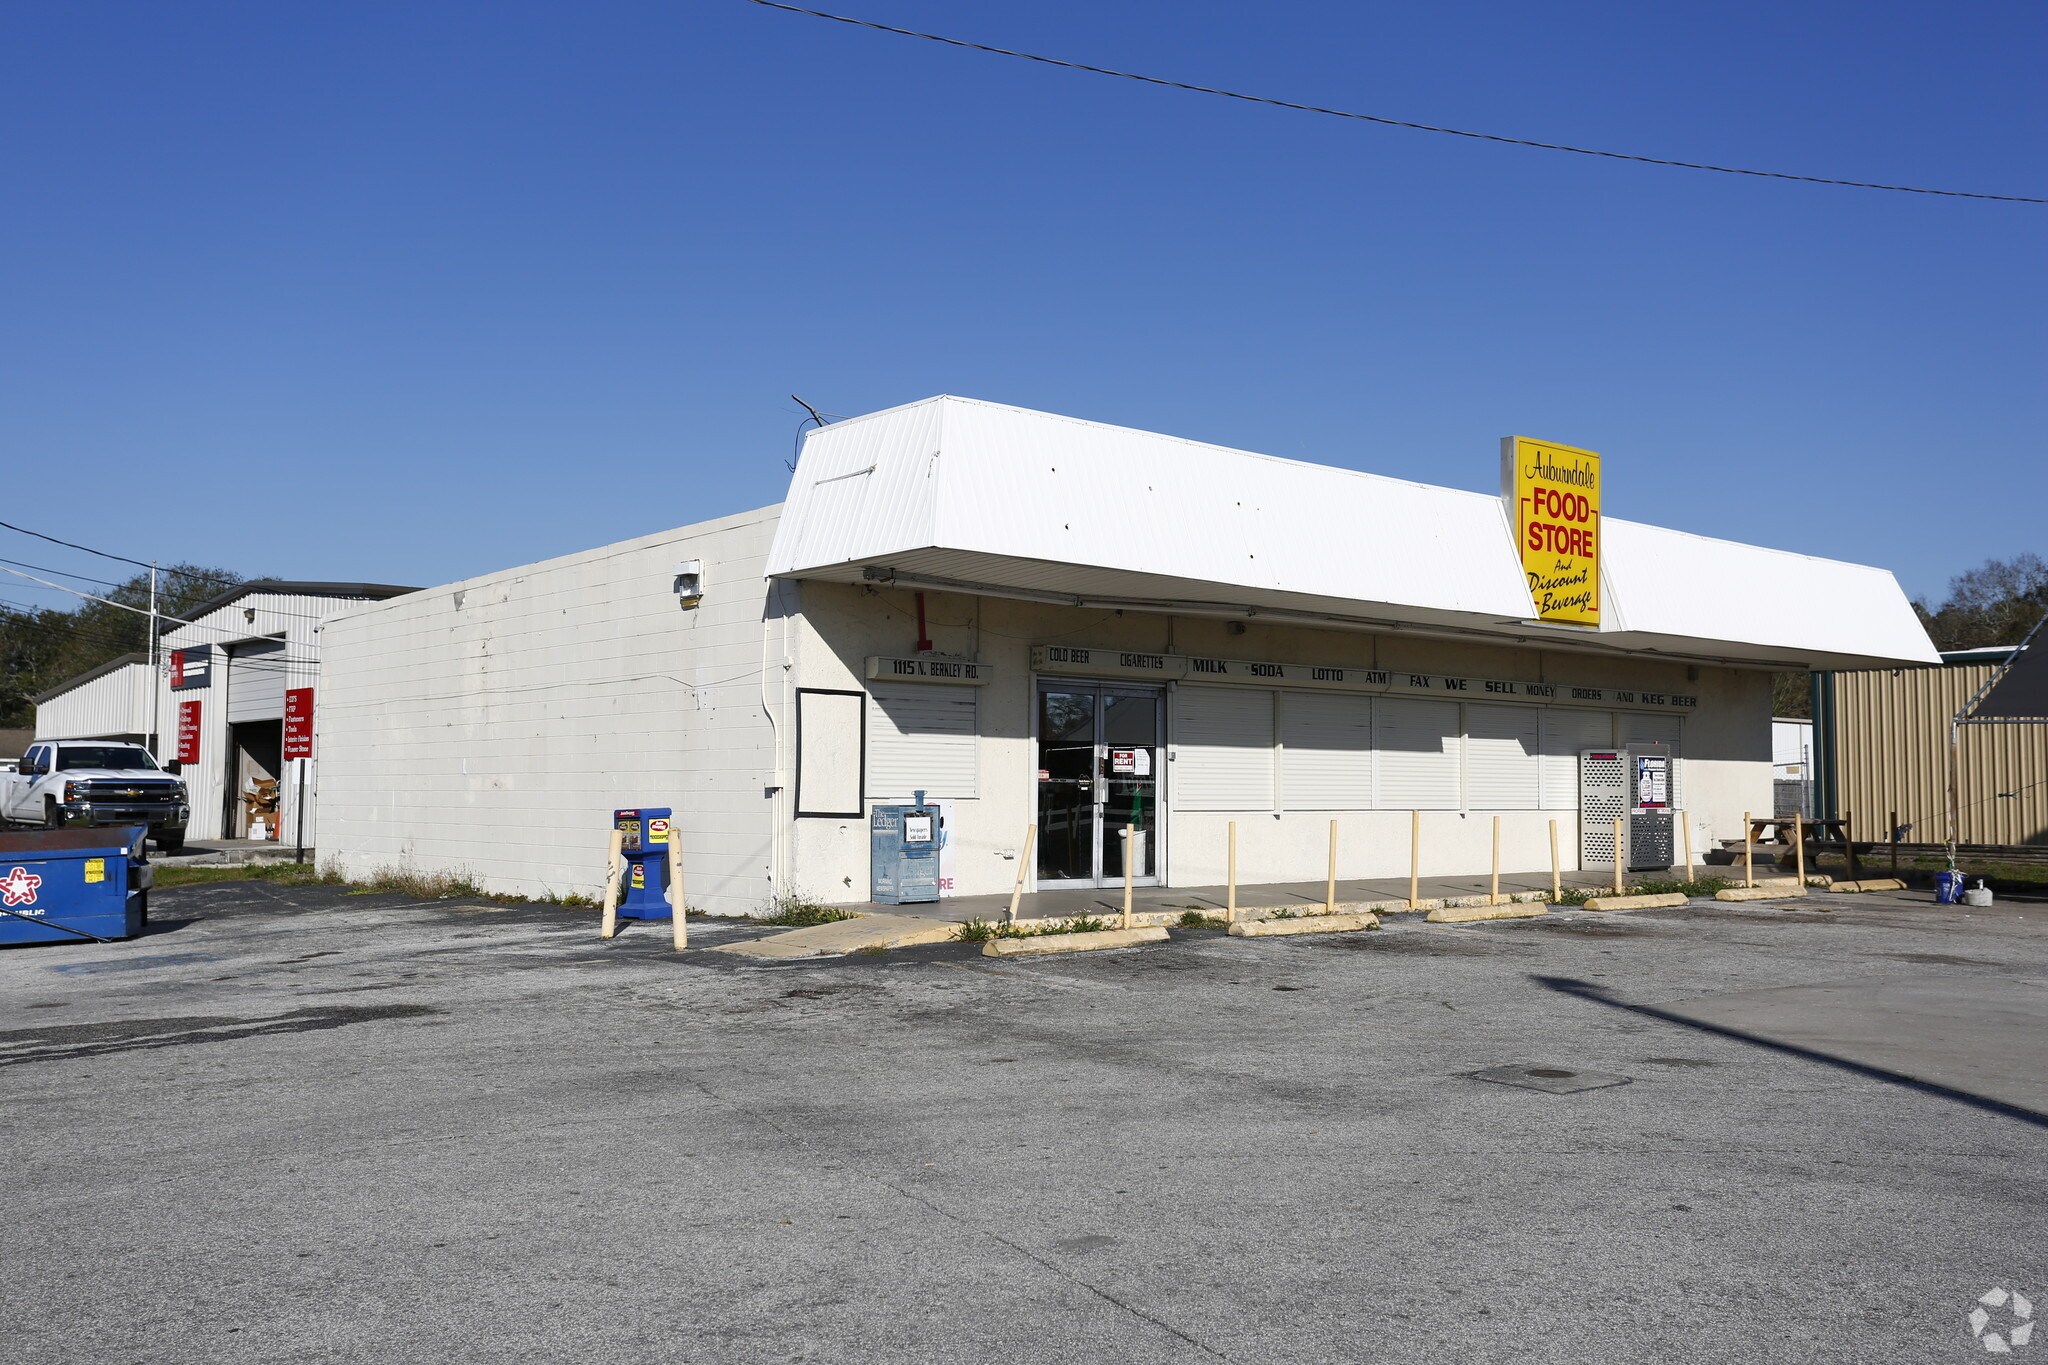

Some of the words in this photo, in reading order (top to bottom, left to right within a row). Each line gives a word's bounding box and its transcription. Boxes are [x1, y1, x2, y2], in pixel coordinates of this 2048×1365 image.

[1525, 451, 1595, 490] Auburndale
[1534, 487, 1590, 523] FOOD
[1528, 521, 1593, 558] STORE
[1554, 559, 1573, 573] And
[1528, 568, 1588, 593] Discount
[1541, 591, 1592, 614] Beverage
[893, 660, 915, 675] 1115
[918, 661, 926, 676] N.
[930, 662, 961, 678] BERKLEY
[965, 665, 979, 679] RD.
[1049, 648, 1068, 662] COLD
[1071, 649, 1089, 664] BEER
[1120, 653, 1163, 669] CIGARETTES
[1193, 659, 1228, 674] MILK
[1251, 663, 1284, 678] SODA
[1312, 668, 1344, 682] LOTTO
[1365, 671, 1386, 684] ATM
[1410, 675, 1430, 688] FAX
[1445, 678, 1467, 690] WE
[1485, 681, 1517, 694] SELL
[1526, 684, 1556, 697] MONEY
[1572, 688, 1602, 700] ORDERS
[1616, 692, 1634, 703] AND
[1642, 693, 1665, 705] KEG
[1671, 695, 1697, 707] BEER
[873, 809, 885, 818] The
[873, 814, 898, 830] Ledger
